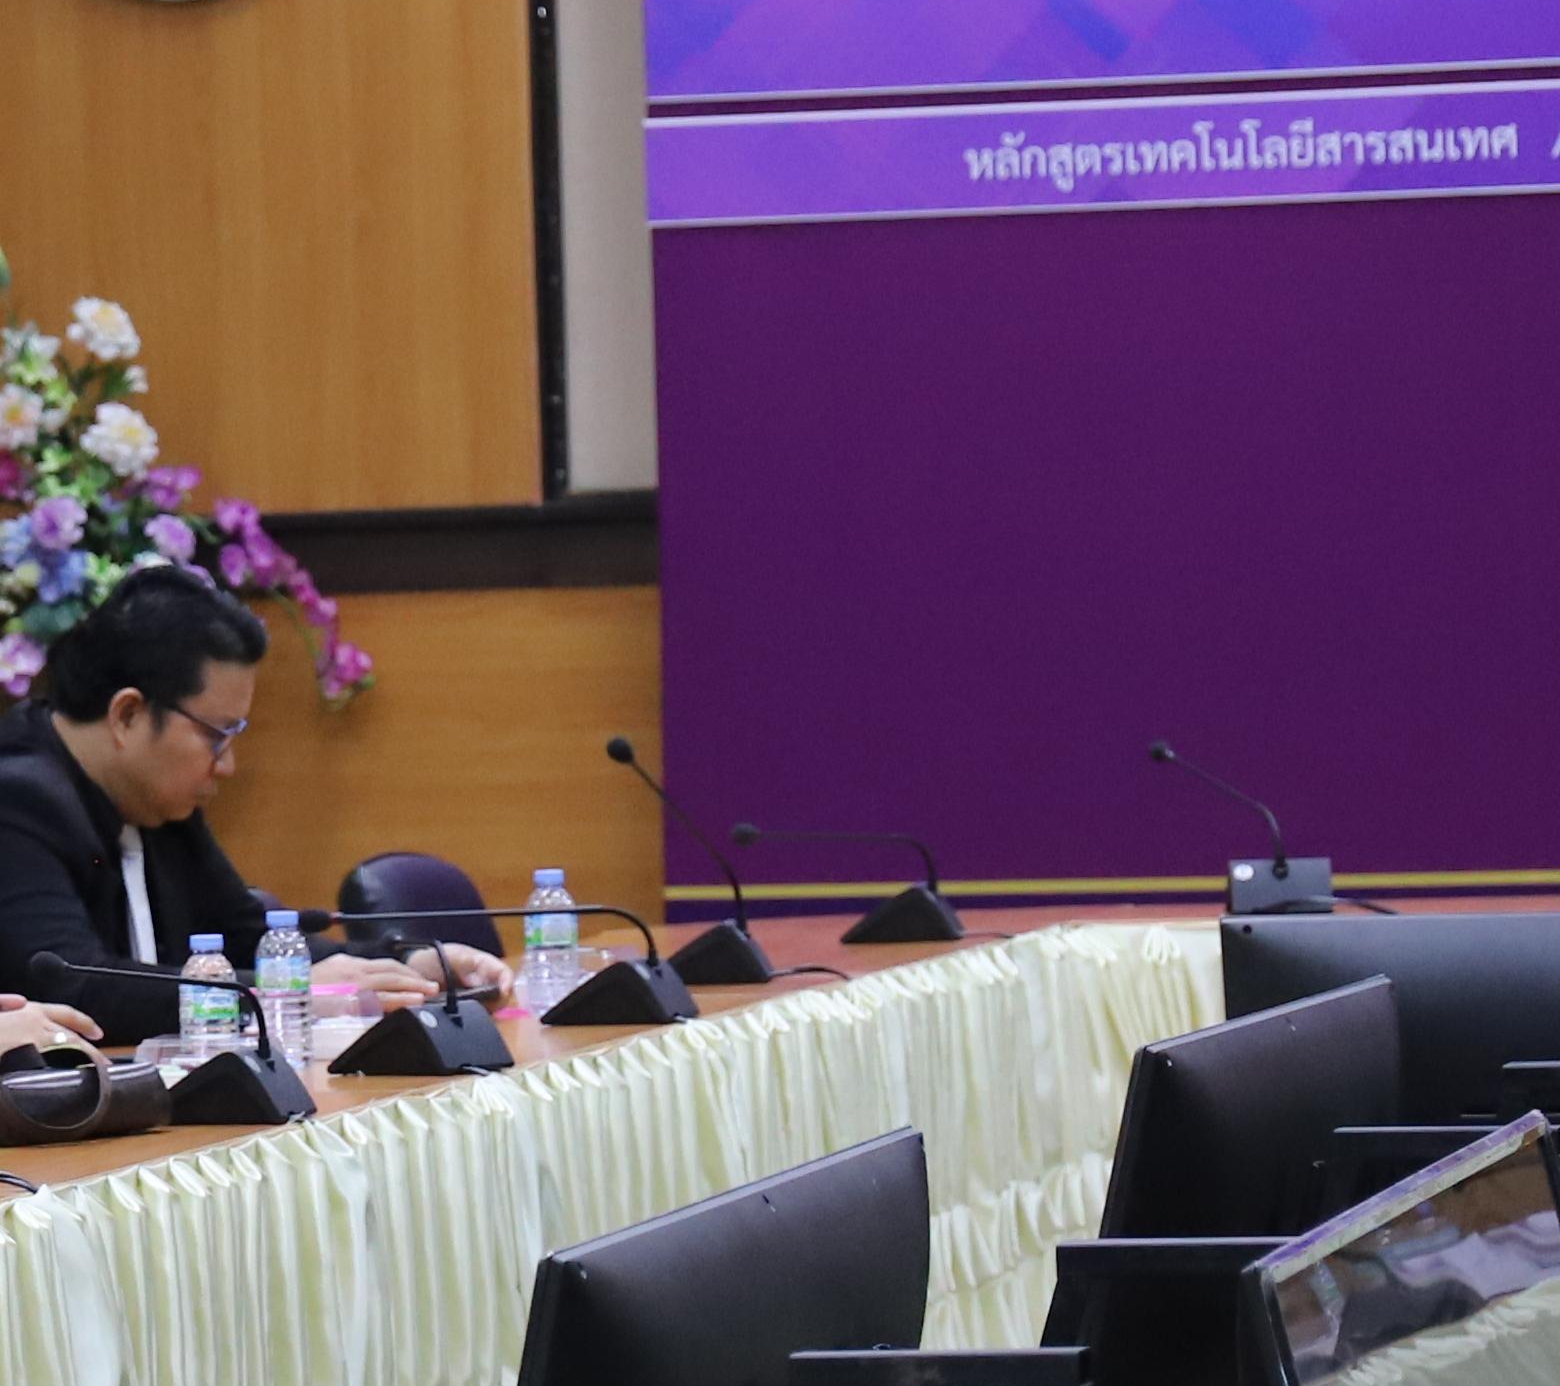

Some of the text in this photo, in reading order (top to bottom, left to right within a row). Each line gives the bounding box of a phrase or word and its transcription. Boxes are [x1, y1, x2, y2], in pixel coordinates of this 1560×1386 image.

[962, 115, 1519, 193] หลักสูตรเทคโนโลยีสารสนเทศ
